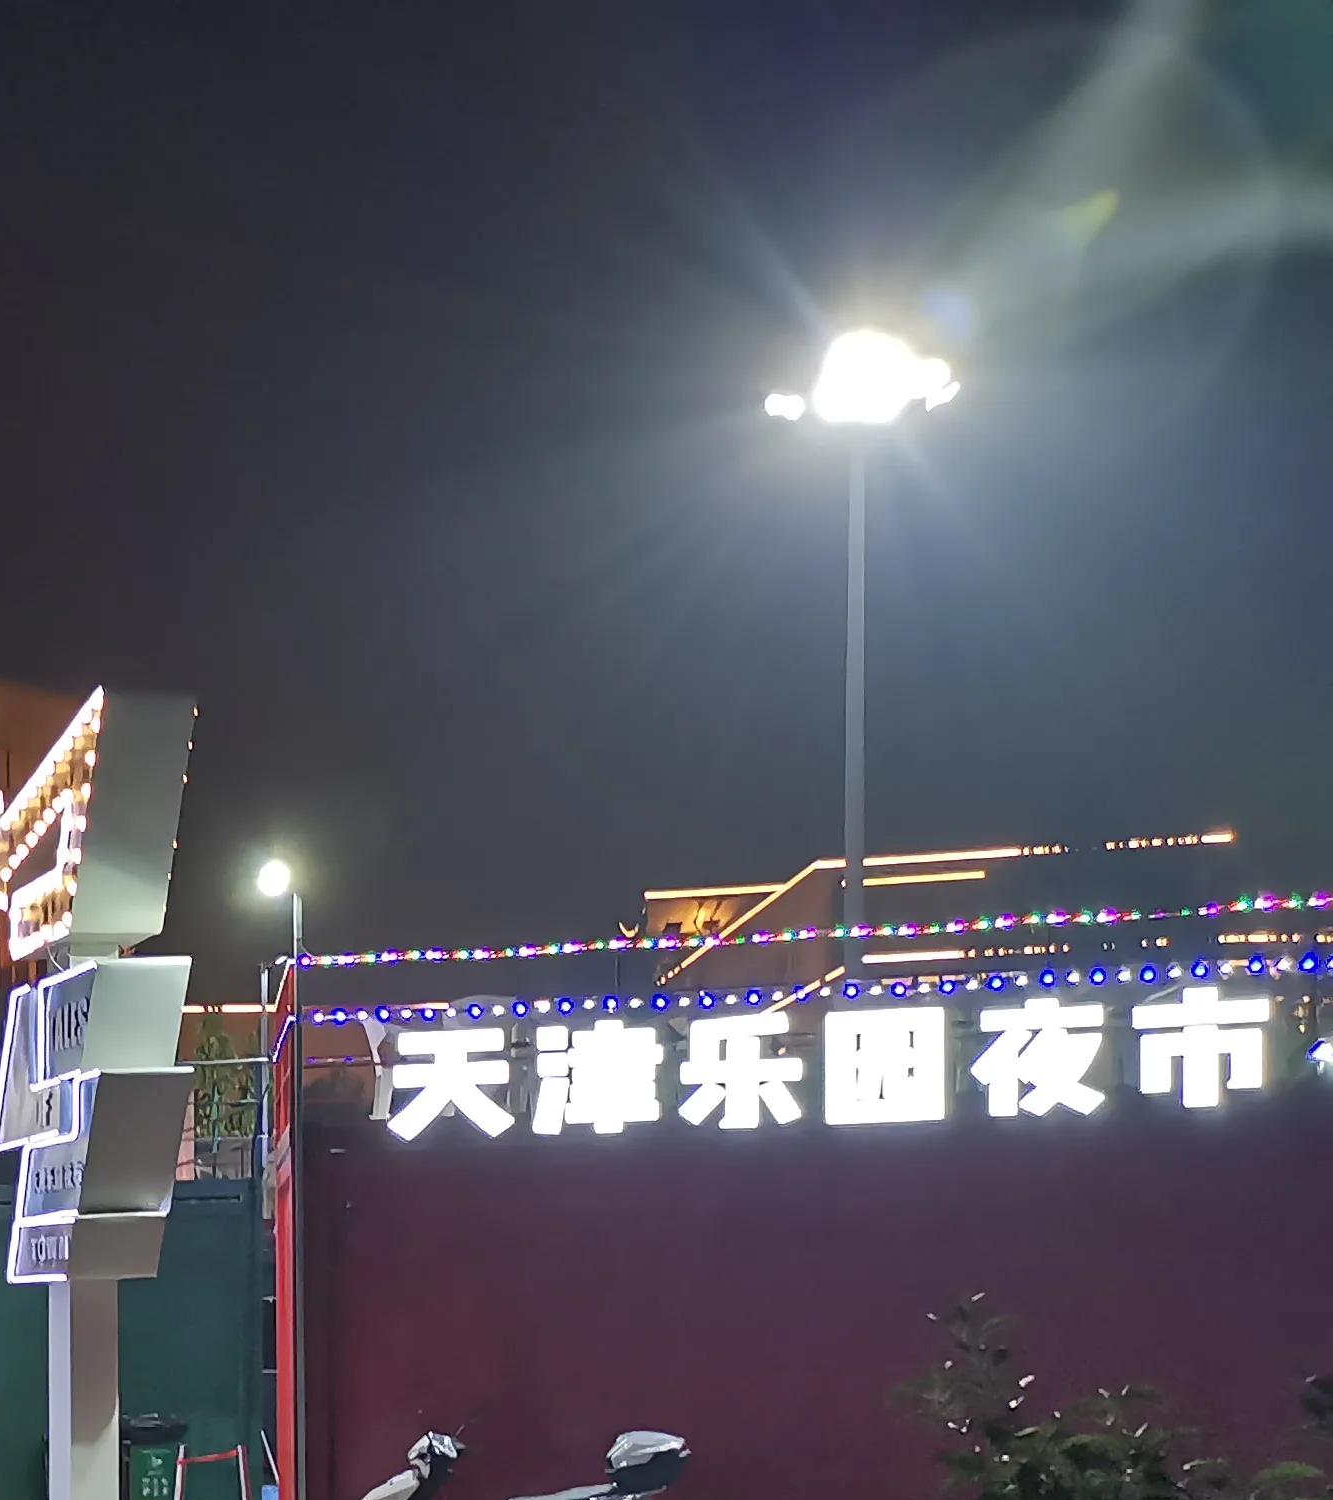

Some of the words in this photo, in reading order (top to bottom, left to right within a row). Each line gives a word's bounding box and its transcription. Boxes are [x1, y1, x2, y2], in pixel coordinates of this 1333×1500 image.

[385, 987, 1270, 1142] 天津乐园夜市
